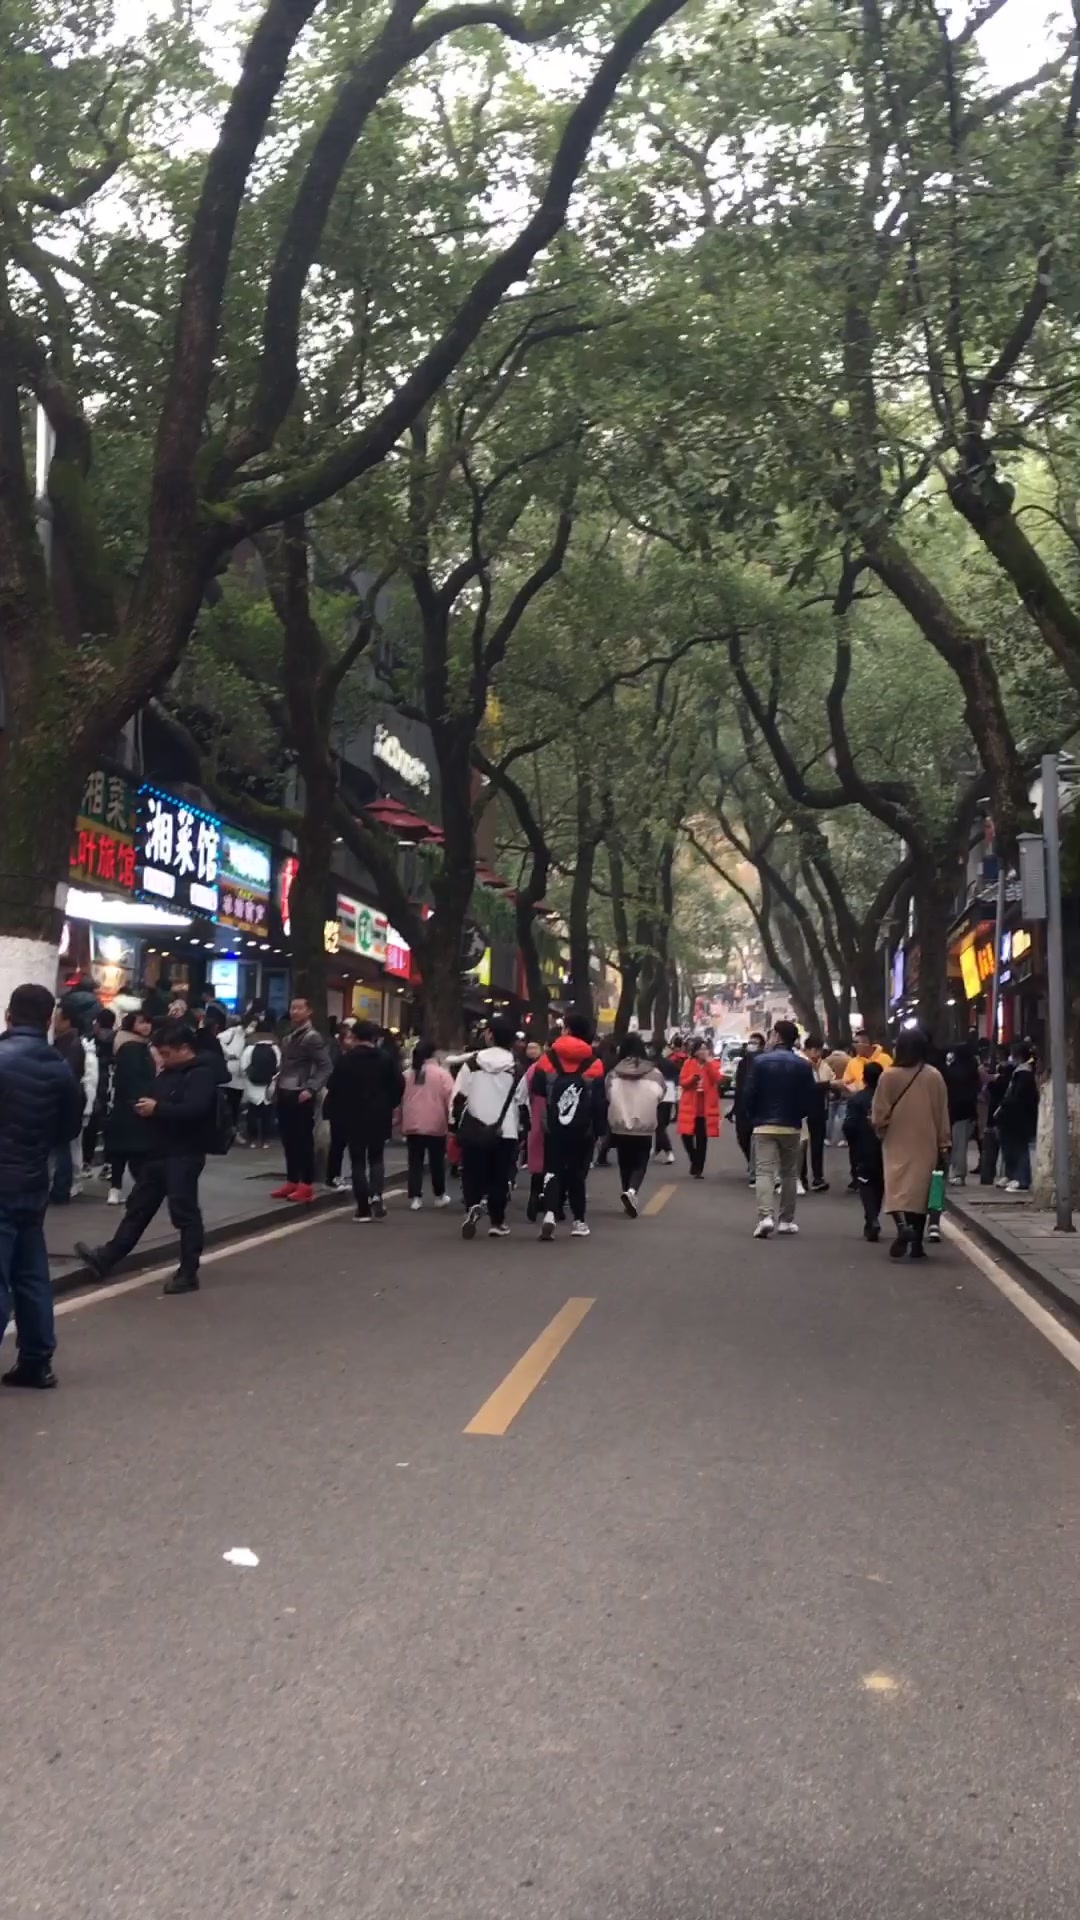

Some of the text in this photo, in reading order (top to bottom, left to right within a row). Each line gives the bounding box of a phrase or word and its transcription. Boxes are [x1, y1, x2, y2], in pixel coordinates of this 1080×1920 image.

[70, 831, 136, 889] 叶旅馆
[145, 798, 220, 882] 湘菜馆
